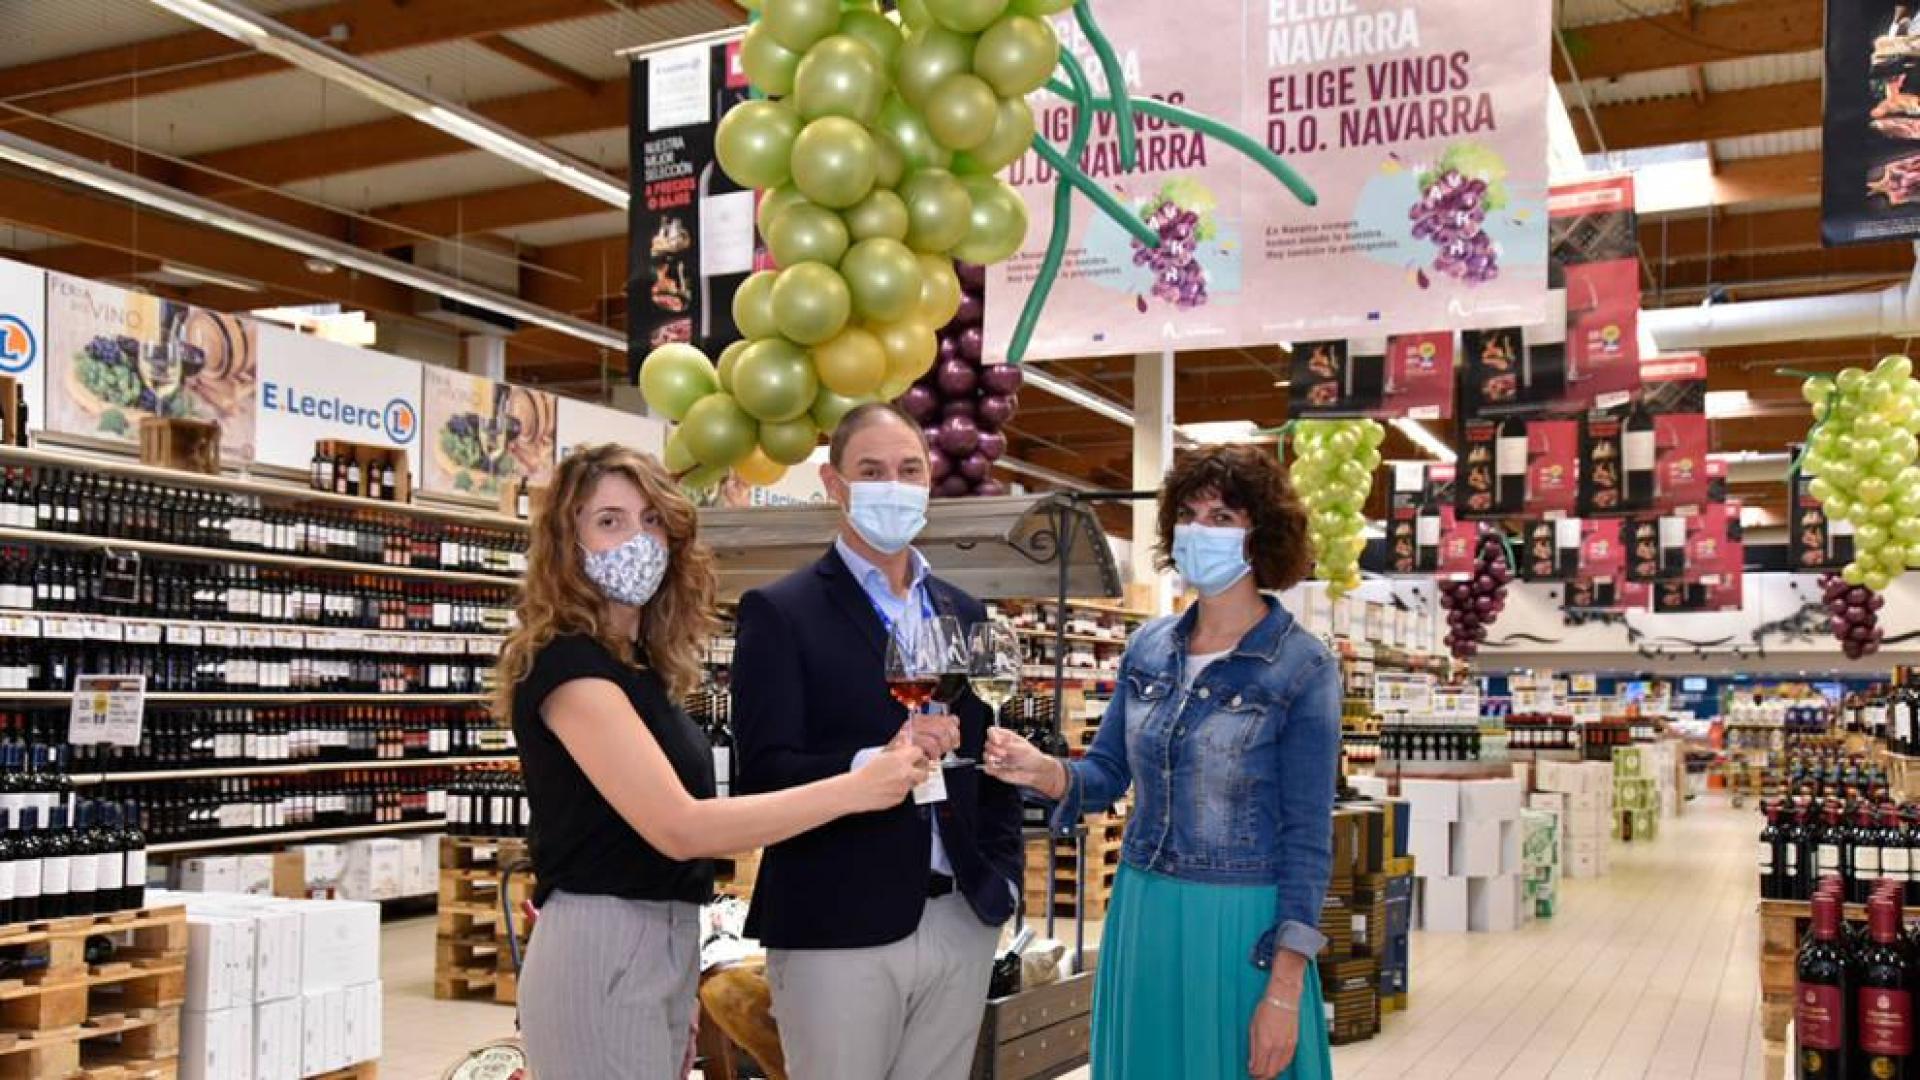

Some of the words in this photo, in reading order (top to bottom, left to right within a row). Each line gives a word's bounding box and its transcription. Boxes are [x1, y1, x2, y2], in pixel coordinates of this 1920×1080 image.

[1267, 8, 1421, 67] NAVARRA
[1268, 66, 1357, 115] ELIGE
[1366, 50, 1471, 102] VINOS
[1267, 115, 1328, 156] D.O.
[1339, 92, 1497, 149] NAVARRA
[262, 381, 381, 430] E.Leclerc
